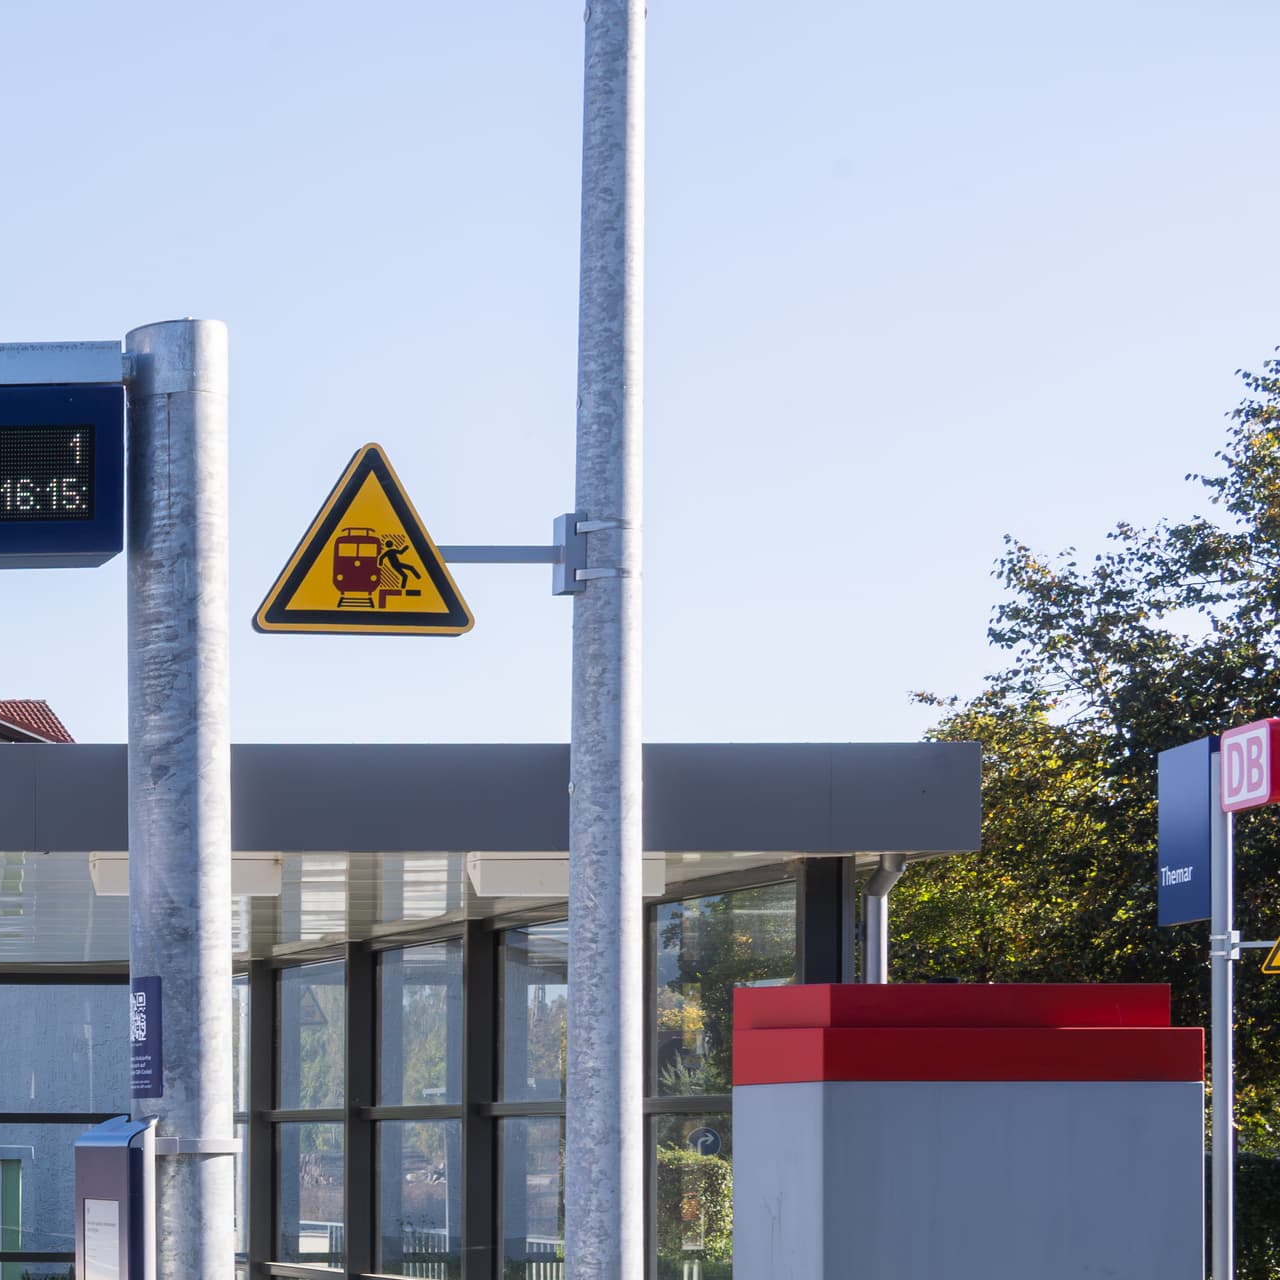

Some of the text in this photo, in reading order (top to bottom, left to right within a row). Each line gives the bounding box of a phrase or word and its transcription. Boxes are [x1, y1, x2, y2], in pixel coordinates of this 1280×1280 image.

[70, 433, 80, 464] 1
[1227, 735, 1265, 798] DB
[1160, 865, 1193, 887] Themar
